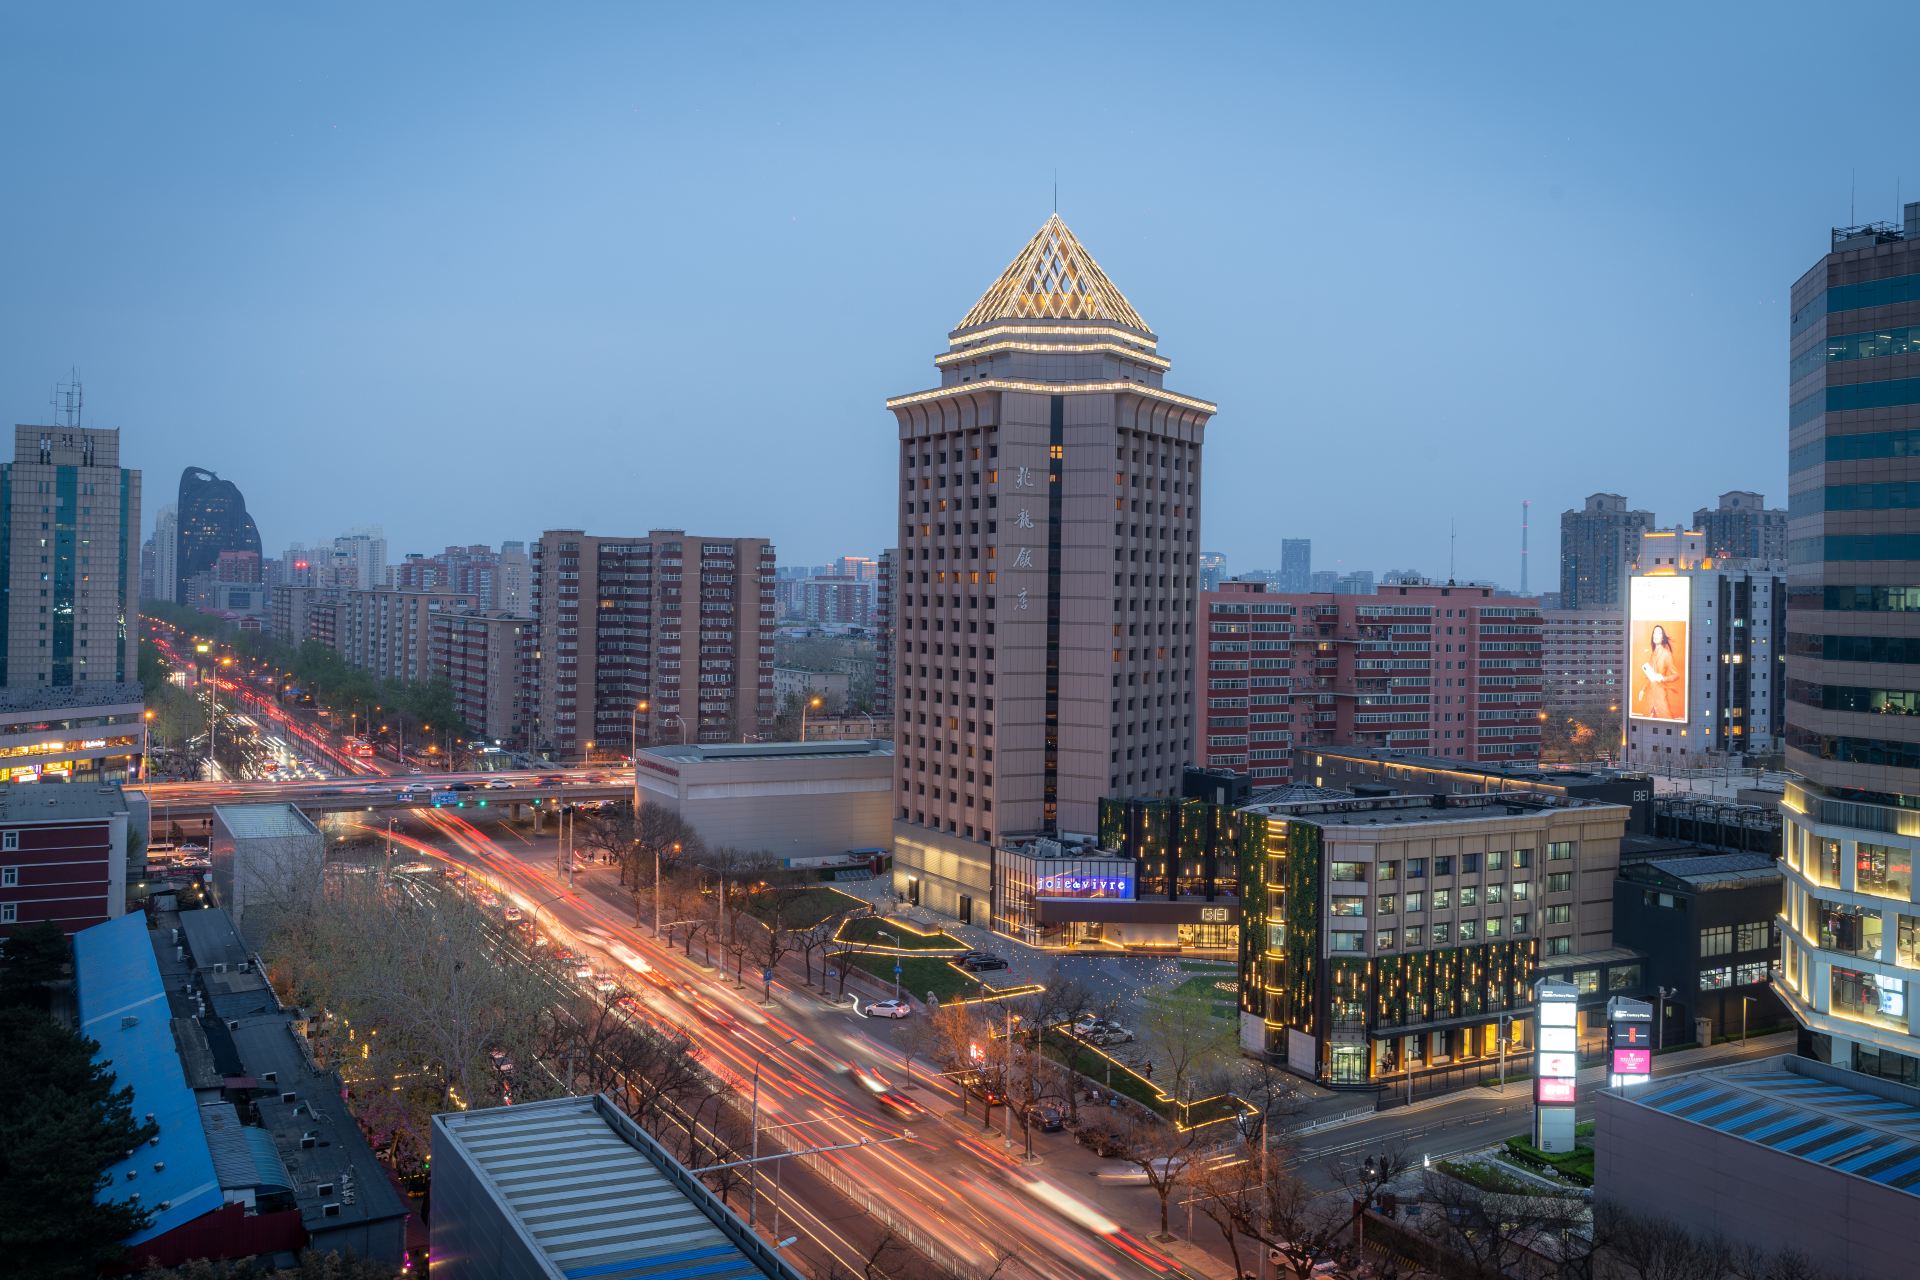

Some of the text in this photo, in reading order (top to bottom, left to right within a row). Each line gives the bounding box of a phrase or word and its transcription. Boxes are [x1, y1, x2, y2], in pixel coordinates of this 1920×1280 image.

[1633, 790, 1649, 801] BEI
[1037, 878, 1072, 889] joie
[1082, 878, 1125, 890] vivre
[1202, 908, 1229, 922] BEI
